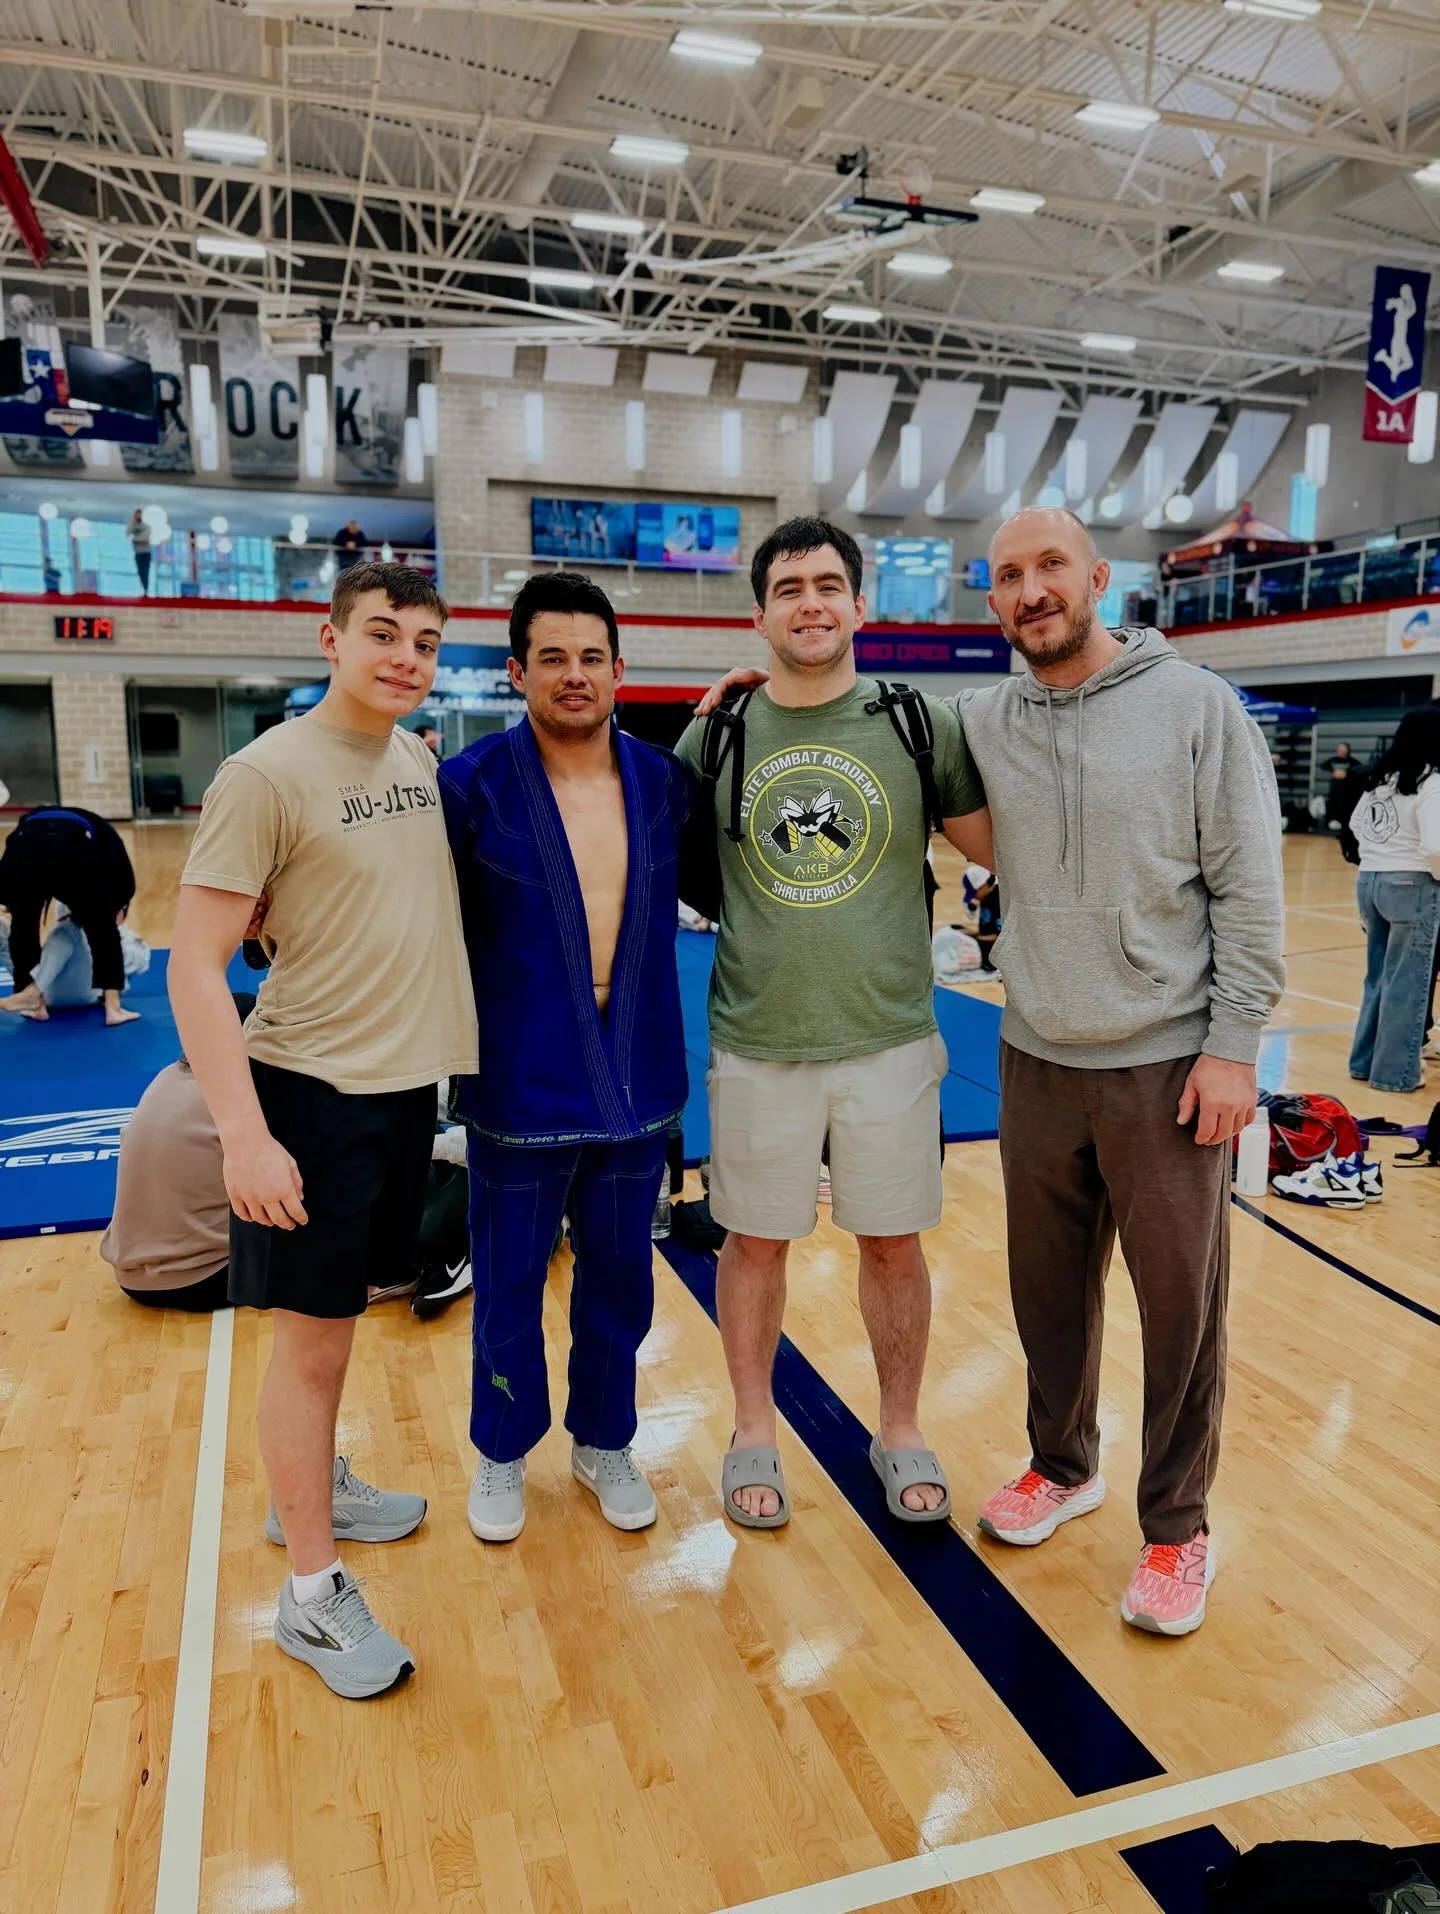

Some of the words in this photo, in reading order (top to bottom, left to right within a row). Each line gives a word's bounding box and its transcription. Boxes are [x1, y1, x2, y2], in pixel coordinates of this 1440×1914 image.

[1376, 410, 1405, 433] 1A
[740, 775, 765, 818] ELITE
[761, 751, 821, 779] COMBAT
[822, 753, 883, 807] ACADEMY
[793, 863, 829, 875] AKB
